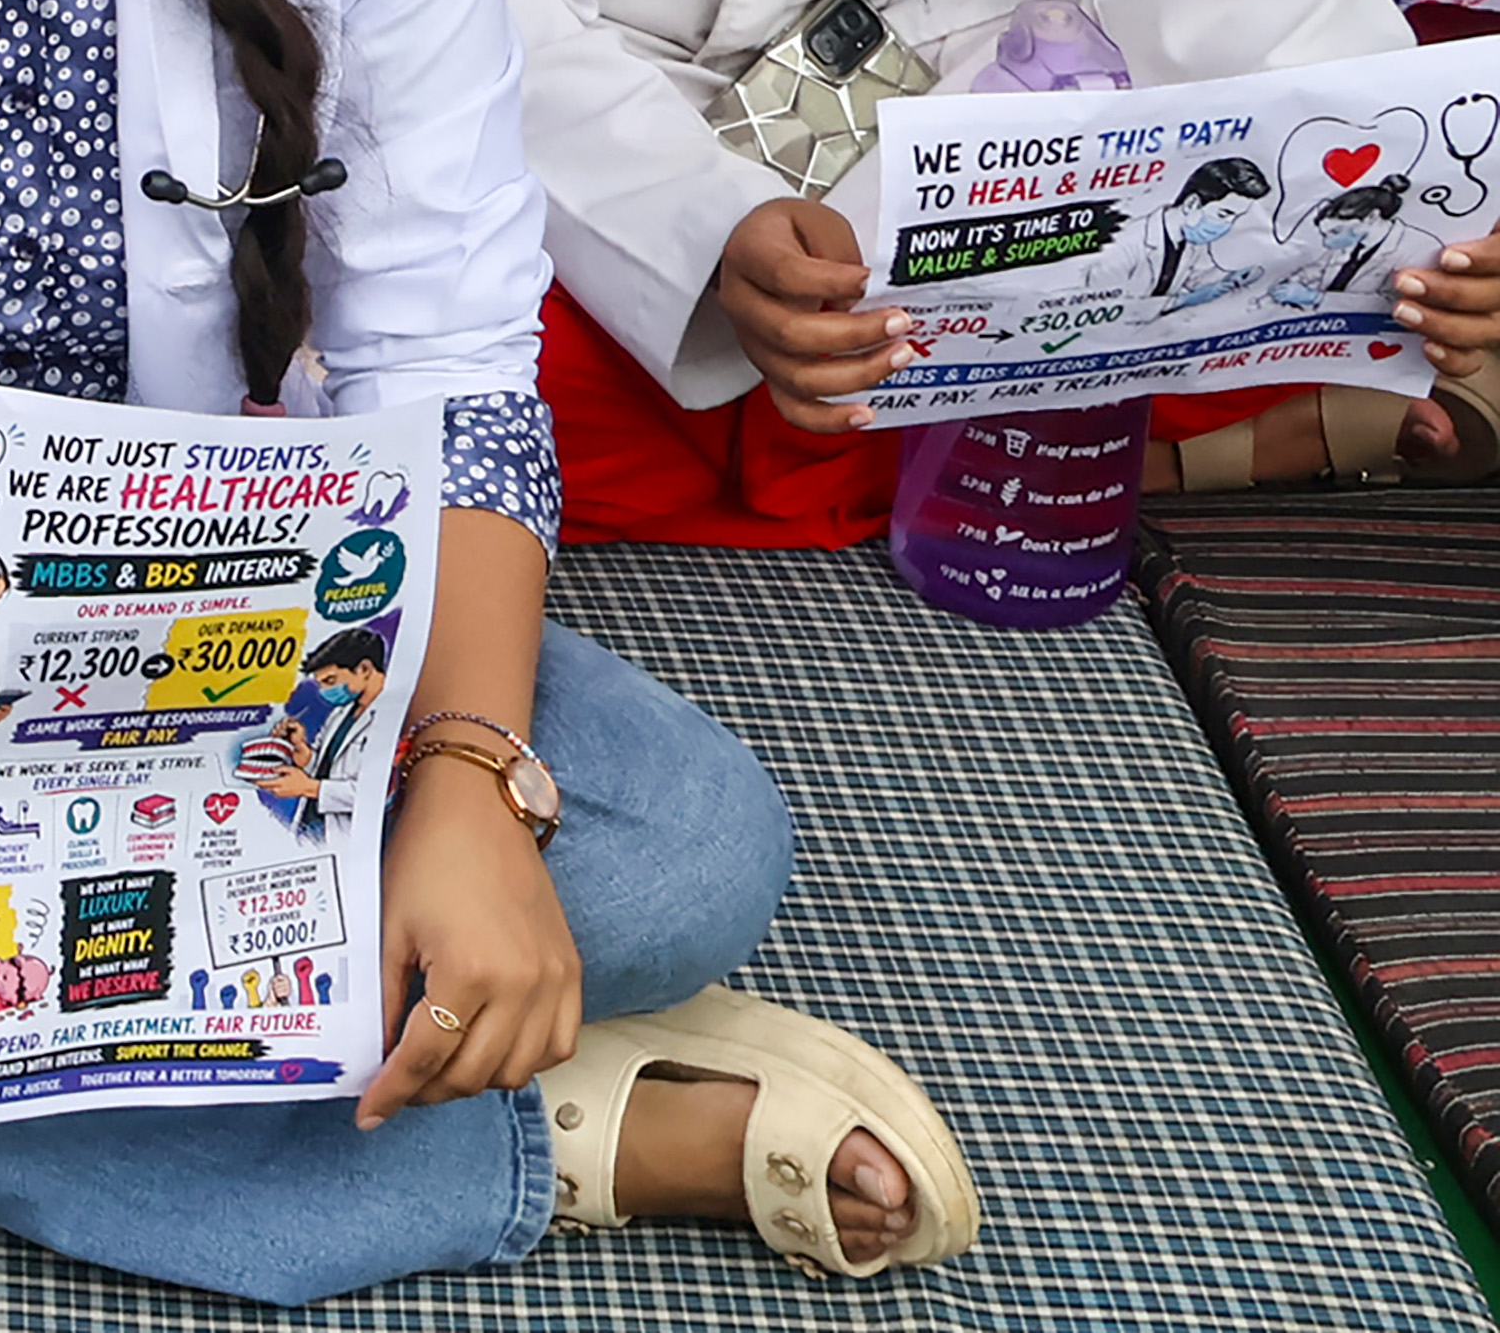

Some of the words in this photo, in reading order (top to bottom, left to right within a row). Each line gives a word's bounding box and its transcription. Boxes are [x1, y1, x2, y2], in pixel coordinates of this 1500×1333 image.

[912, 143, 963, 174] WE
[978, 135, 1083, 171] CHOSE
[1097, 127, 1165, 161] THIS
[1177, 116, 1253, 148] PATH
[1198, 349, 1250, 376] FAIR
[1257, 341, 1353, 367] FUTURE.
[19, 648, 139, 685] ₹12,300
[176, 636, 296, 674] ₹30,000
